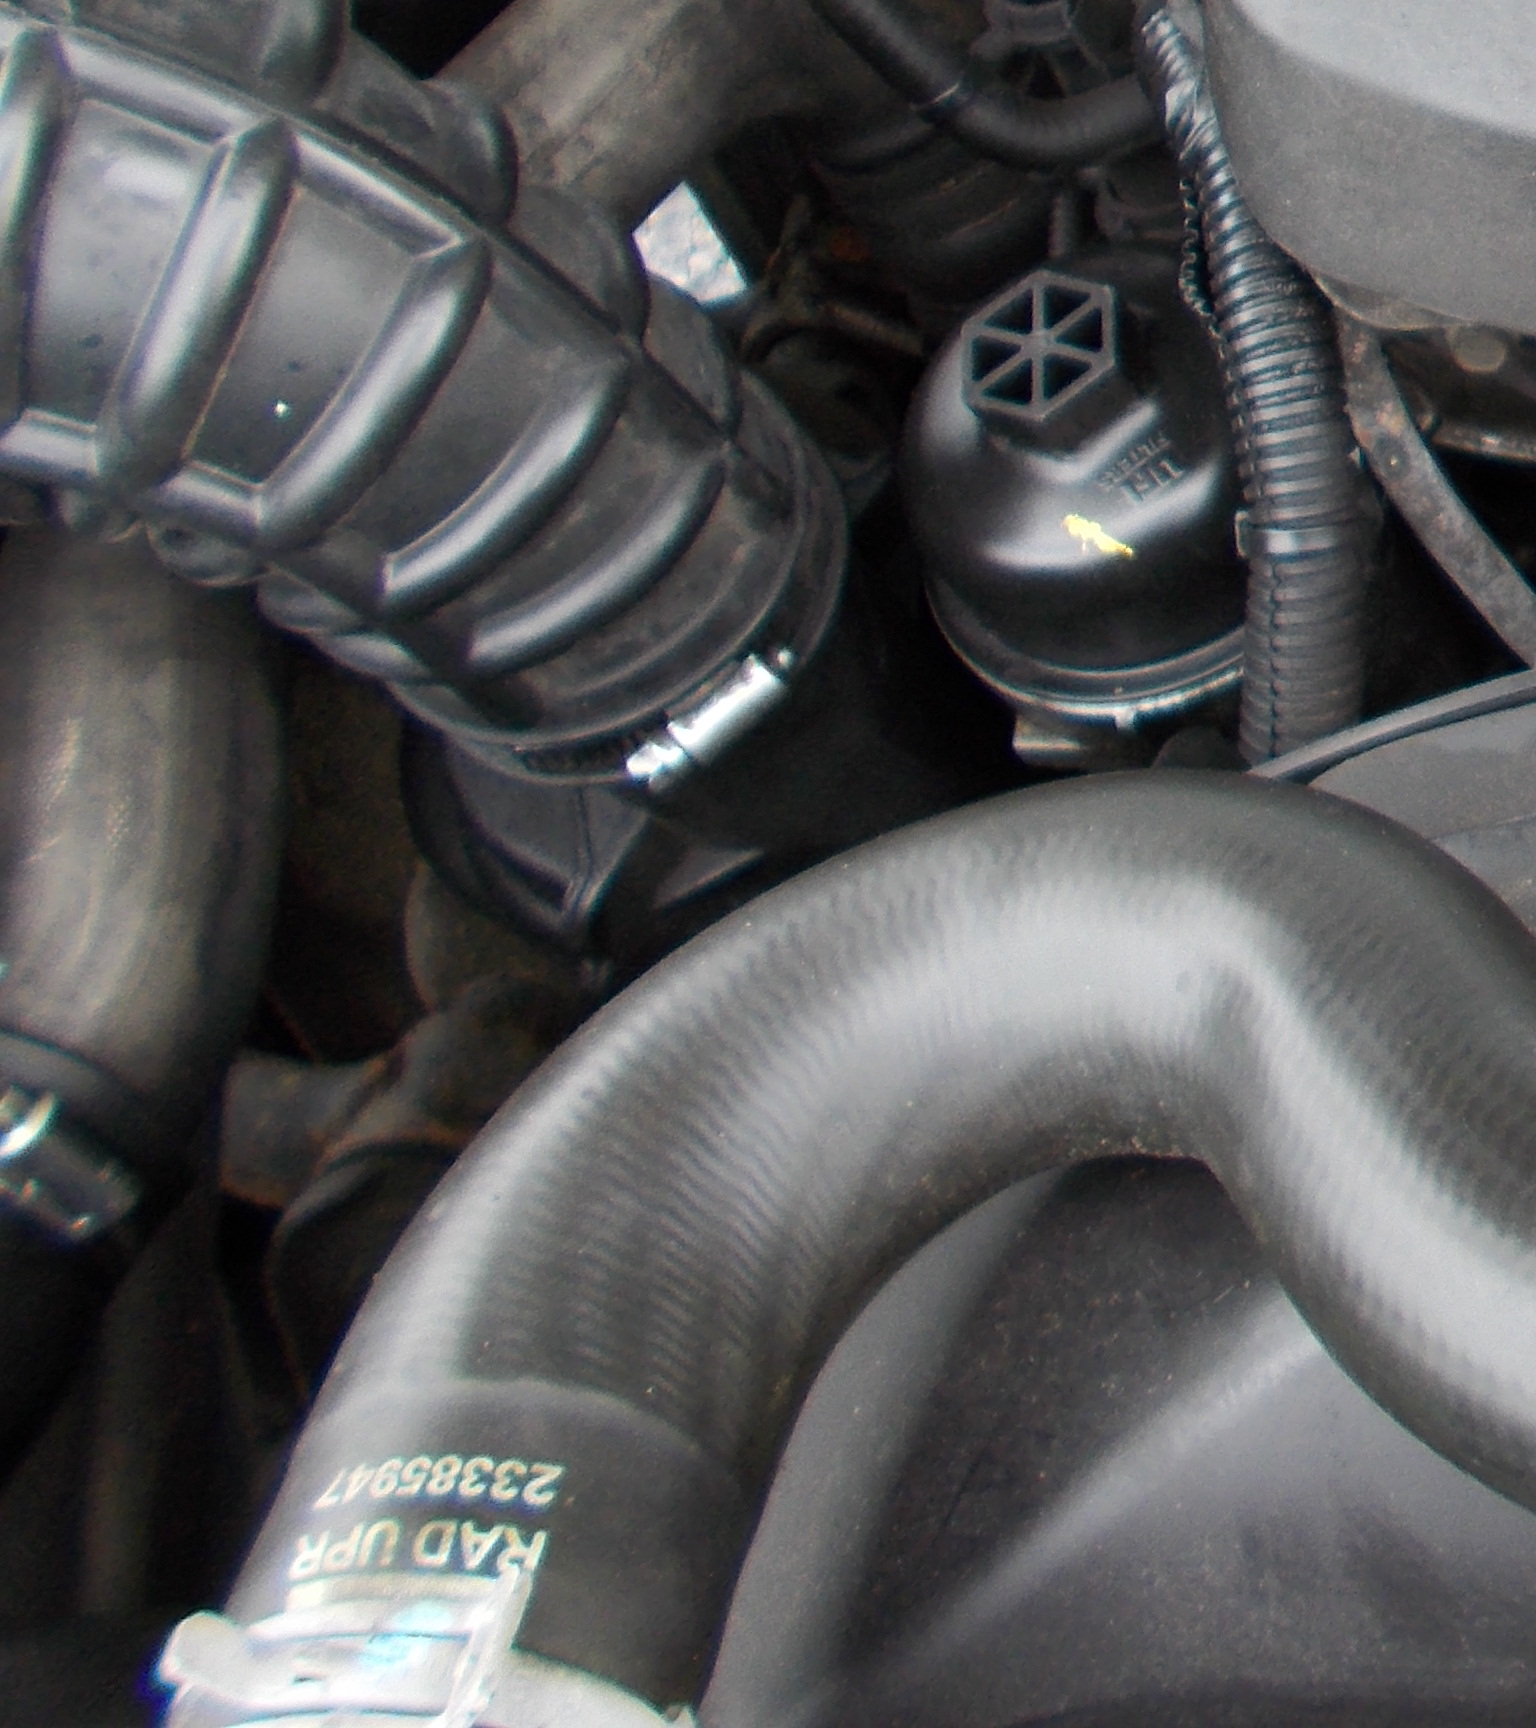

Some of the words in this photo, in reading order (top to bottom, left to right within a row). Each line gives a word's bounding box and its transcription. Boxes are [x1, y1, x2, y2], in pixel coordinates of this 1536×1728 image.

[310, 1454, 567, 1509] 23385947
[289, 1517, 400, 1580] UPR
[411, 1518, 549, 1573] RAD
